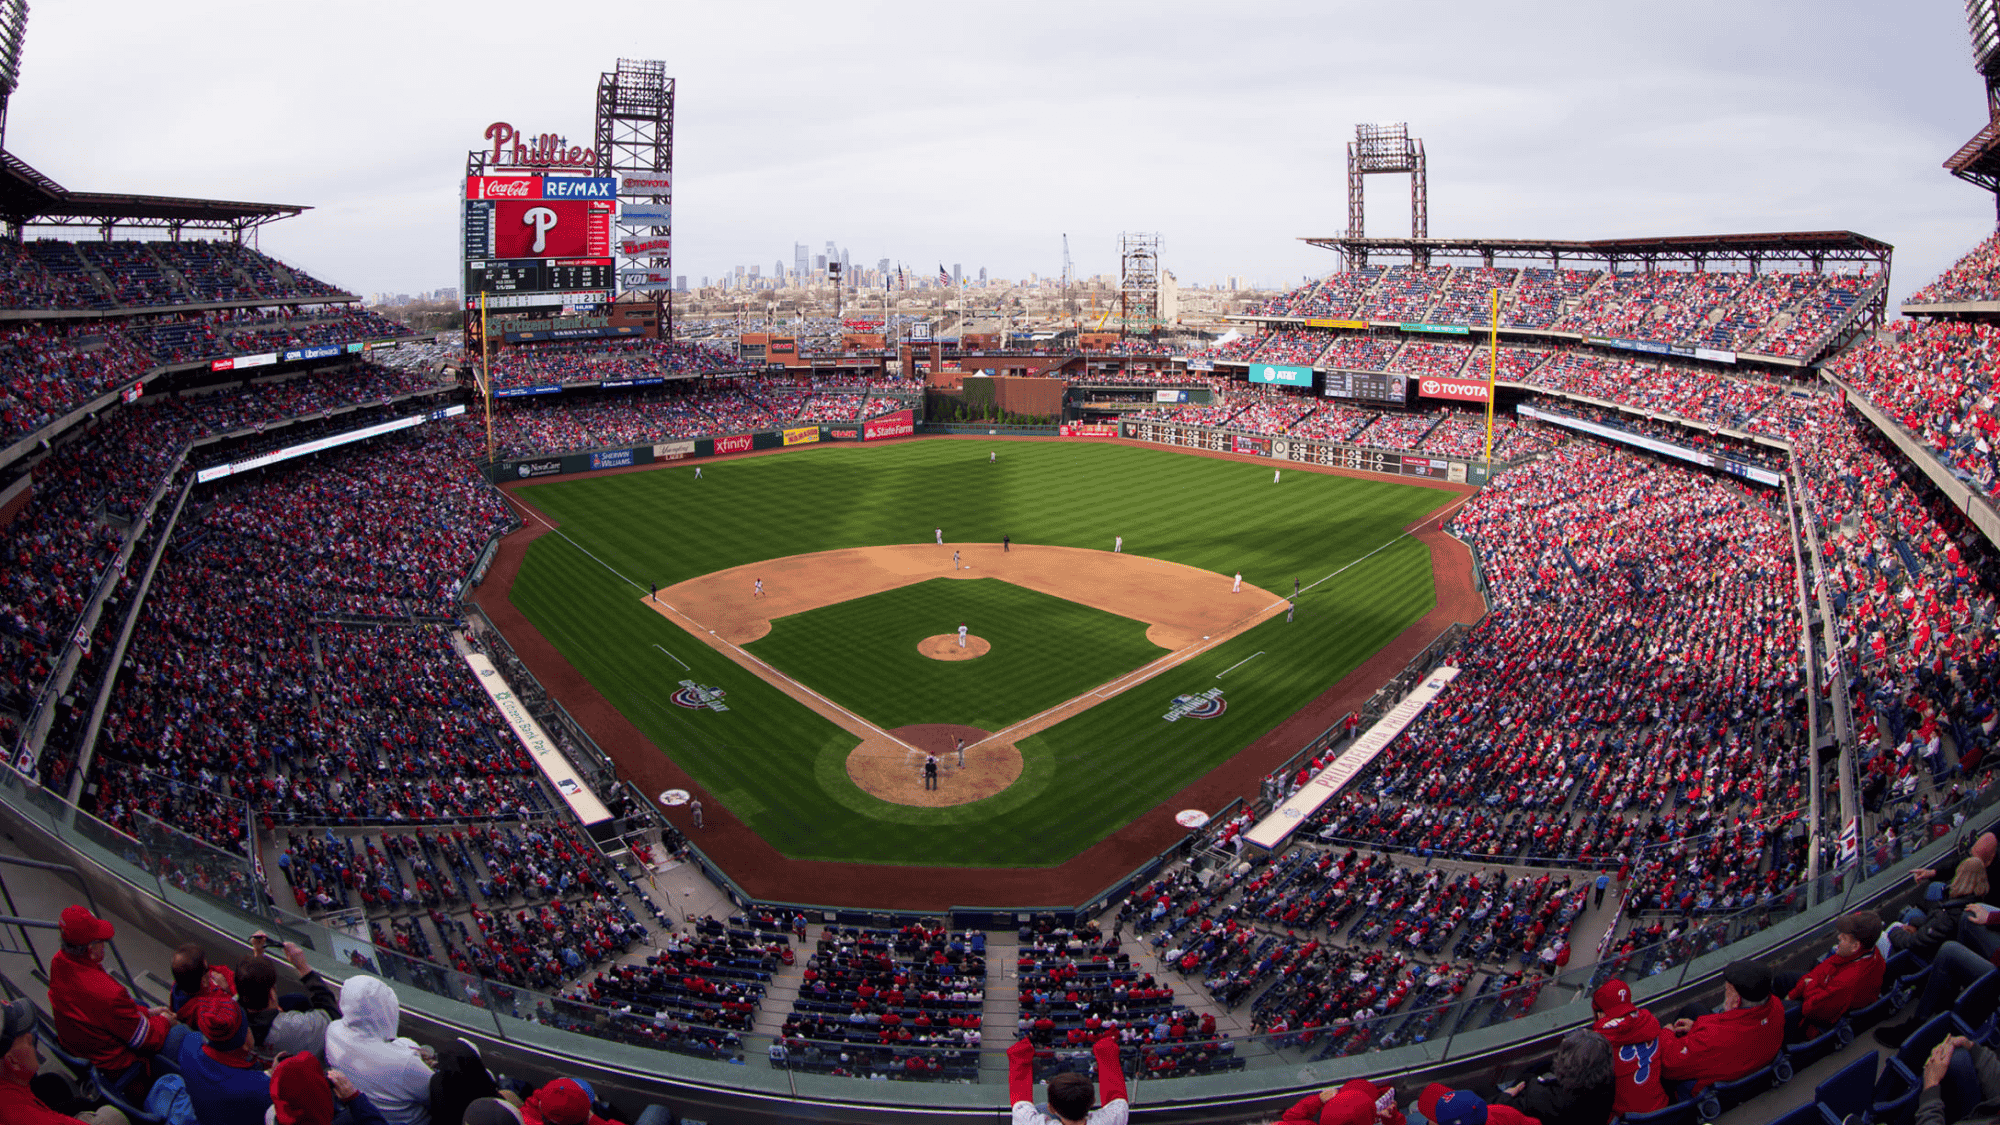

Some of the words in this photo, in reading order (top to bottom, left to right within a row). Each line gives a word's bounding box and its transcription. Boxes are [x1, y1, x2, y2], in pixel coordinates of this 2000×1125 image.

[485, 122, 598, 167] Phillies
[487, 180, 531, 196] Coca-Cola
[547, 182, 610, 196] RE/MAX
[636, 180, 669, 188] TOYOTA
[523, 206, 558, 253] P
[504, 319, 551, 332] Citizens
[553, 316, 582, 329] Bank
[583, 313, 609, 328] Park
[1277, 370, 1298, 380] AT&T
[1442, 383, 1488, 397] TOYOTA
[876, 426, 899, 437] State
[899, 424, 913, 435] Farm
[716, 437, 751, 453] xfinity
[601, 458, 631, 467] WILLIAMS
[602, 451, 630, 460] SHERWIN
[530, 462, 561, 472] NovaCare
[503, 701, 525, 723] Citizens
[532, 740, 551, 756] Park
[1315, 731, 1391, 789] PHILADELPHIA
[1383, 699, 1424, 730] PHILLIES
